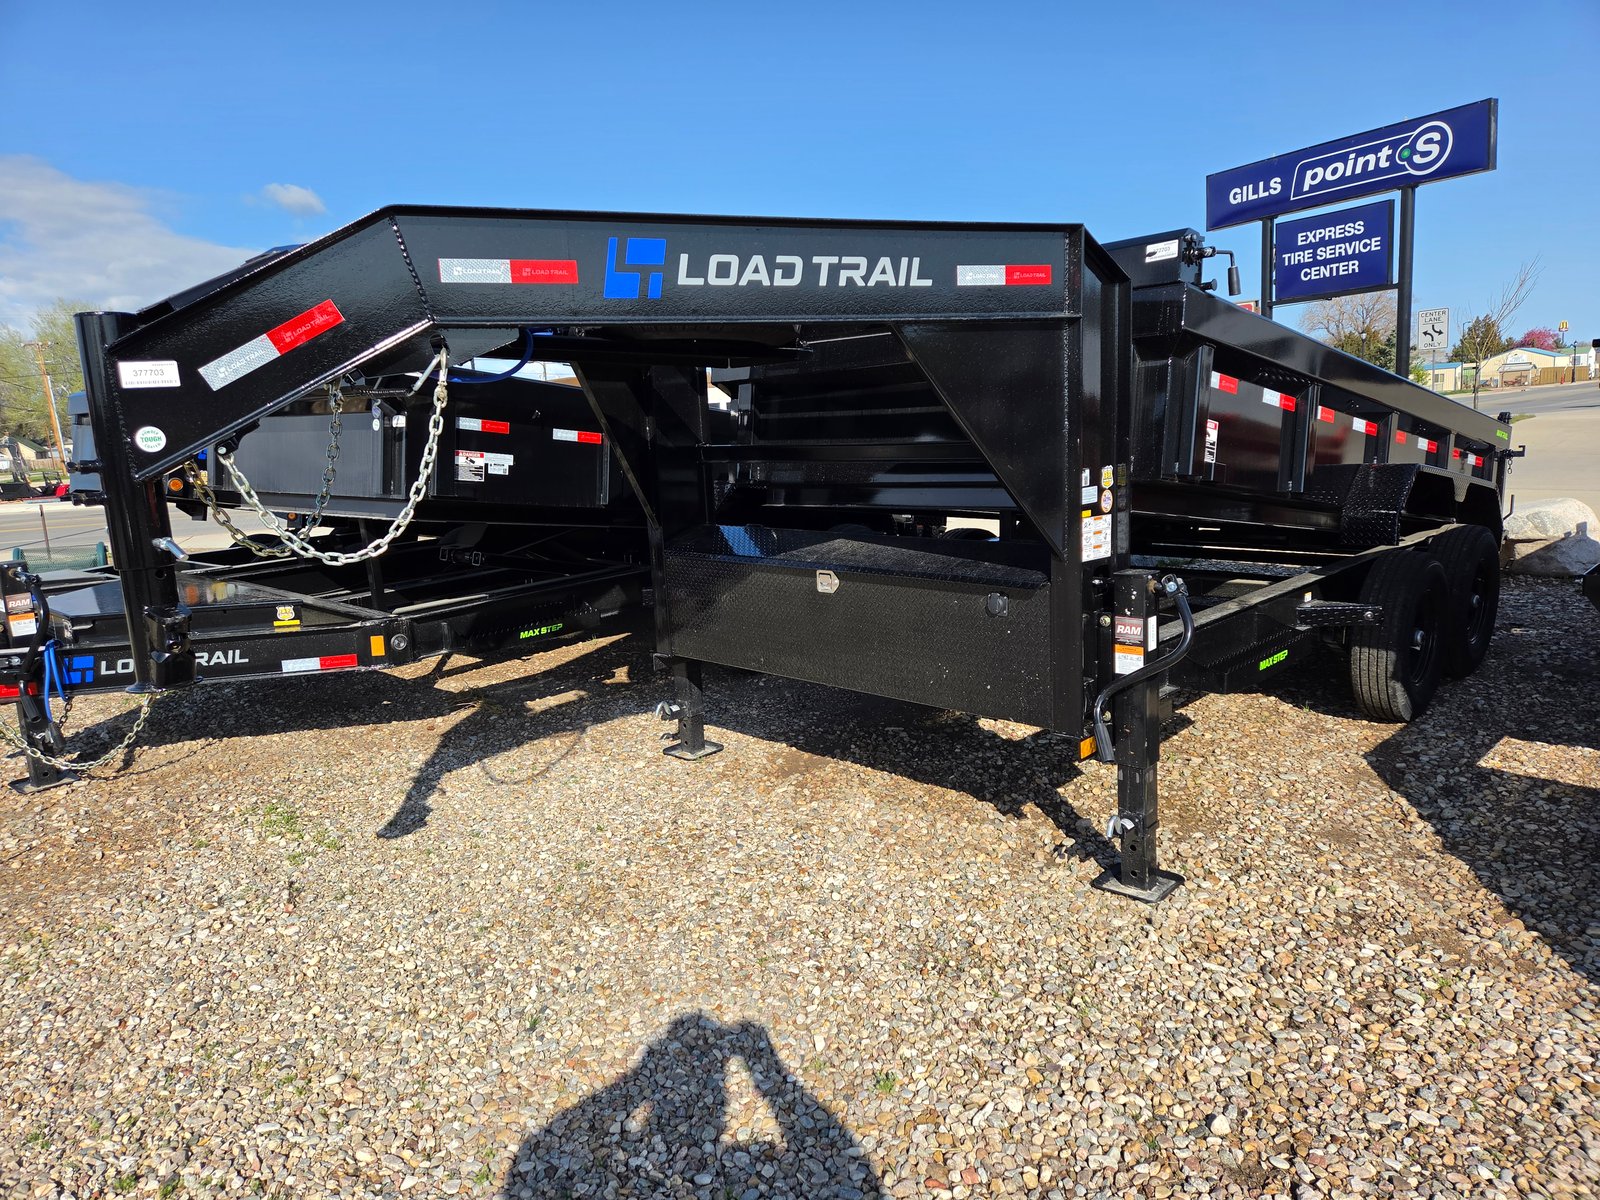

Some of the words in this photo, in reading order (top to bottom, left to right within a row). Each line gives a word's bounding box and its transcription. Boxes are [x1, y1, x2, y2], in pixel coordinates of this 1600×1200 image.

[1229, 176, 1281, 205] GILLS
[1302, 144, 1393, 191] point
[1412, 131, 1441, 163] S
[1297, 220, 1365, 246] EXPRESS
[1282, 248, 1313, 266] TIRE
[1316, 237, 1381, 261] SERVICE
[677, 253, 804, 287] LOAD
[812, 255, 933, 287] TRAIL
[1300, 260, 1359, 281] CENTER
[1420, 310, 1447, 318] CENTER
[293, 323, 312, 336] LOAD
[132, 368, 165, 377] 377703
[9, 599, 30, 608] RAM
[520, 628, 540, 639] MAX
[540, 623, 563, 635] STEP
[1116, 624, 1141, 635] RAM
[101, 658, 134, 675] LO
[194, 649, 249, 666] RAIL
